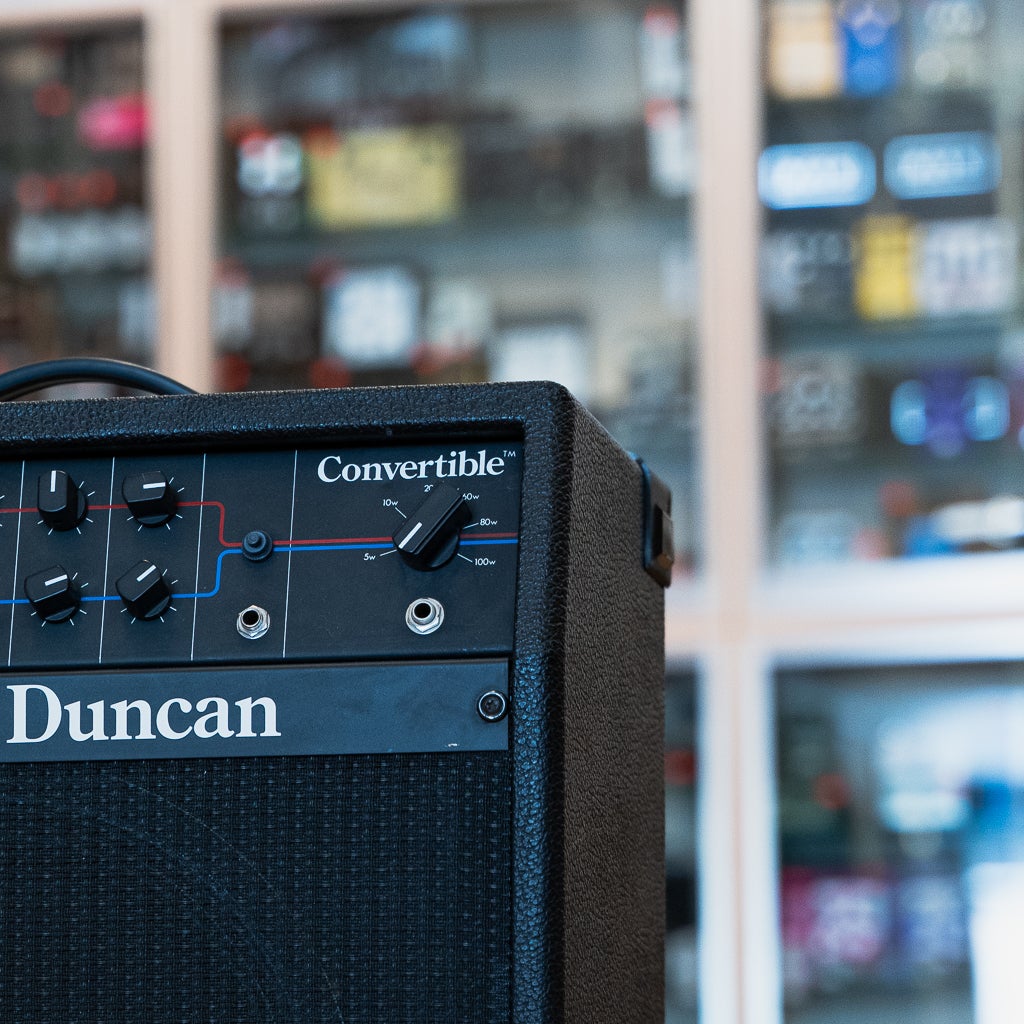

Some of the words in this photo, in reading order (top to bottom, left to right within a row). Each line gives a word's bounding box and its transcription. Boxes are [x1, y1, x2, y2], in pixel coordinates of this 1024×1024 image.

[317, 450, 505, 482] Convertible
[382, 498, 399, 507] 10w
[479, 517, 498, 526] 80w
[474, 557, 496, 566] 100w
[6, 684, 282, 744] Duncan
